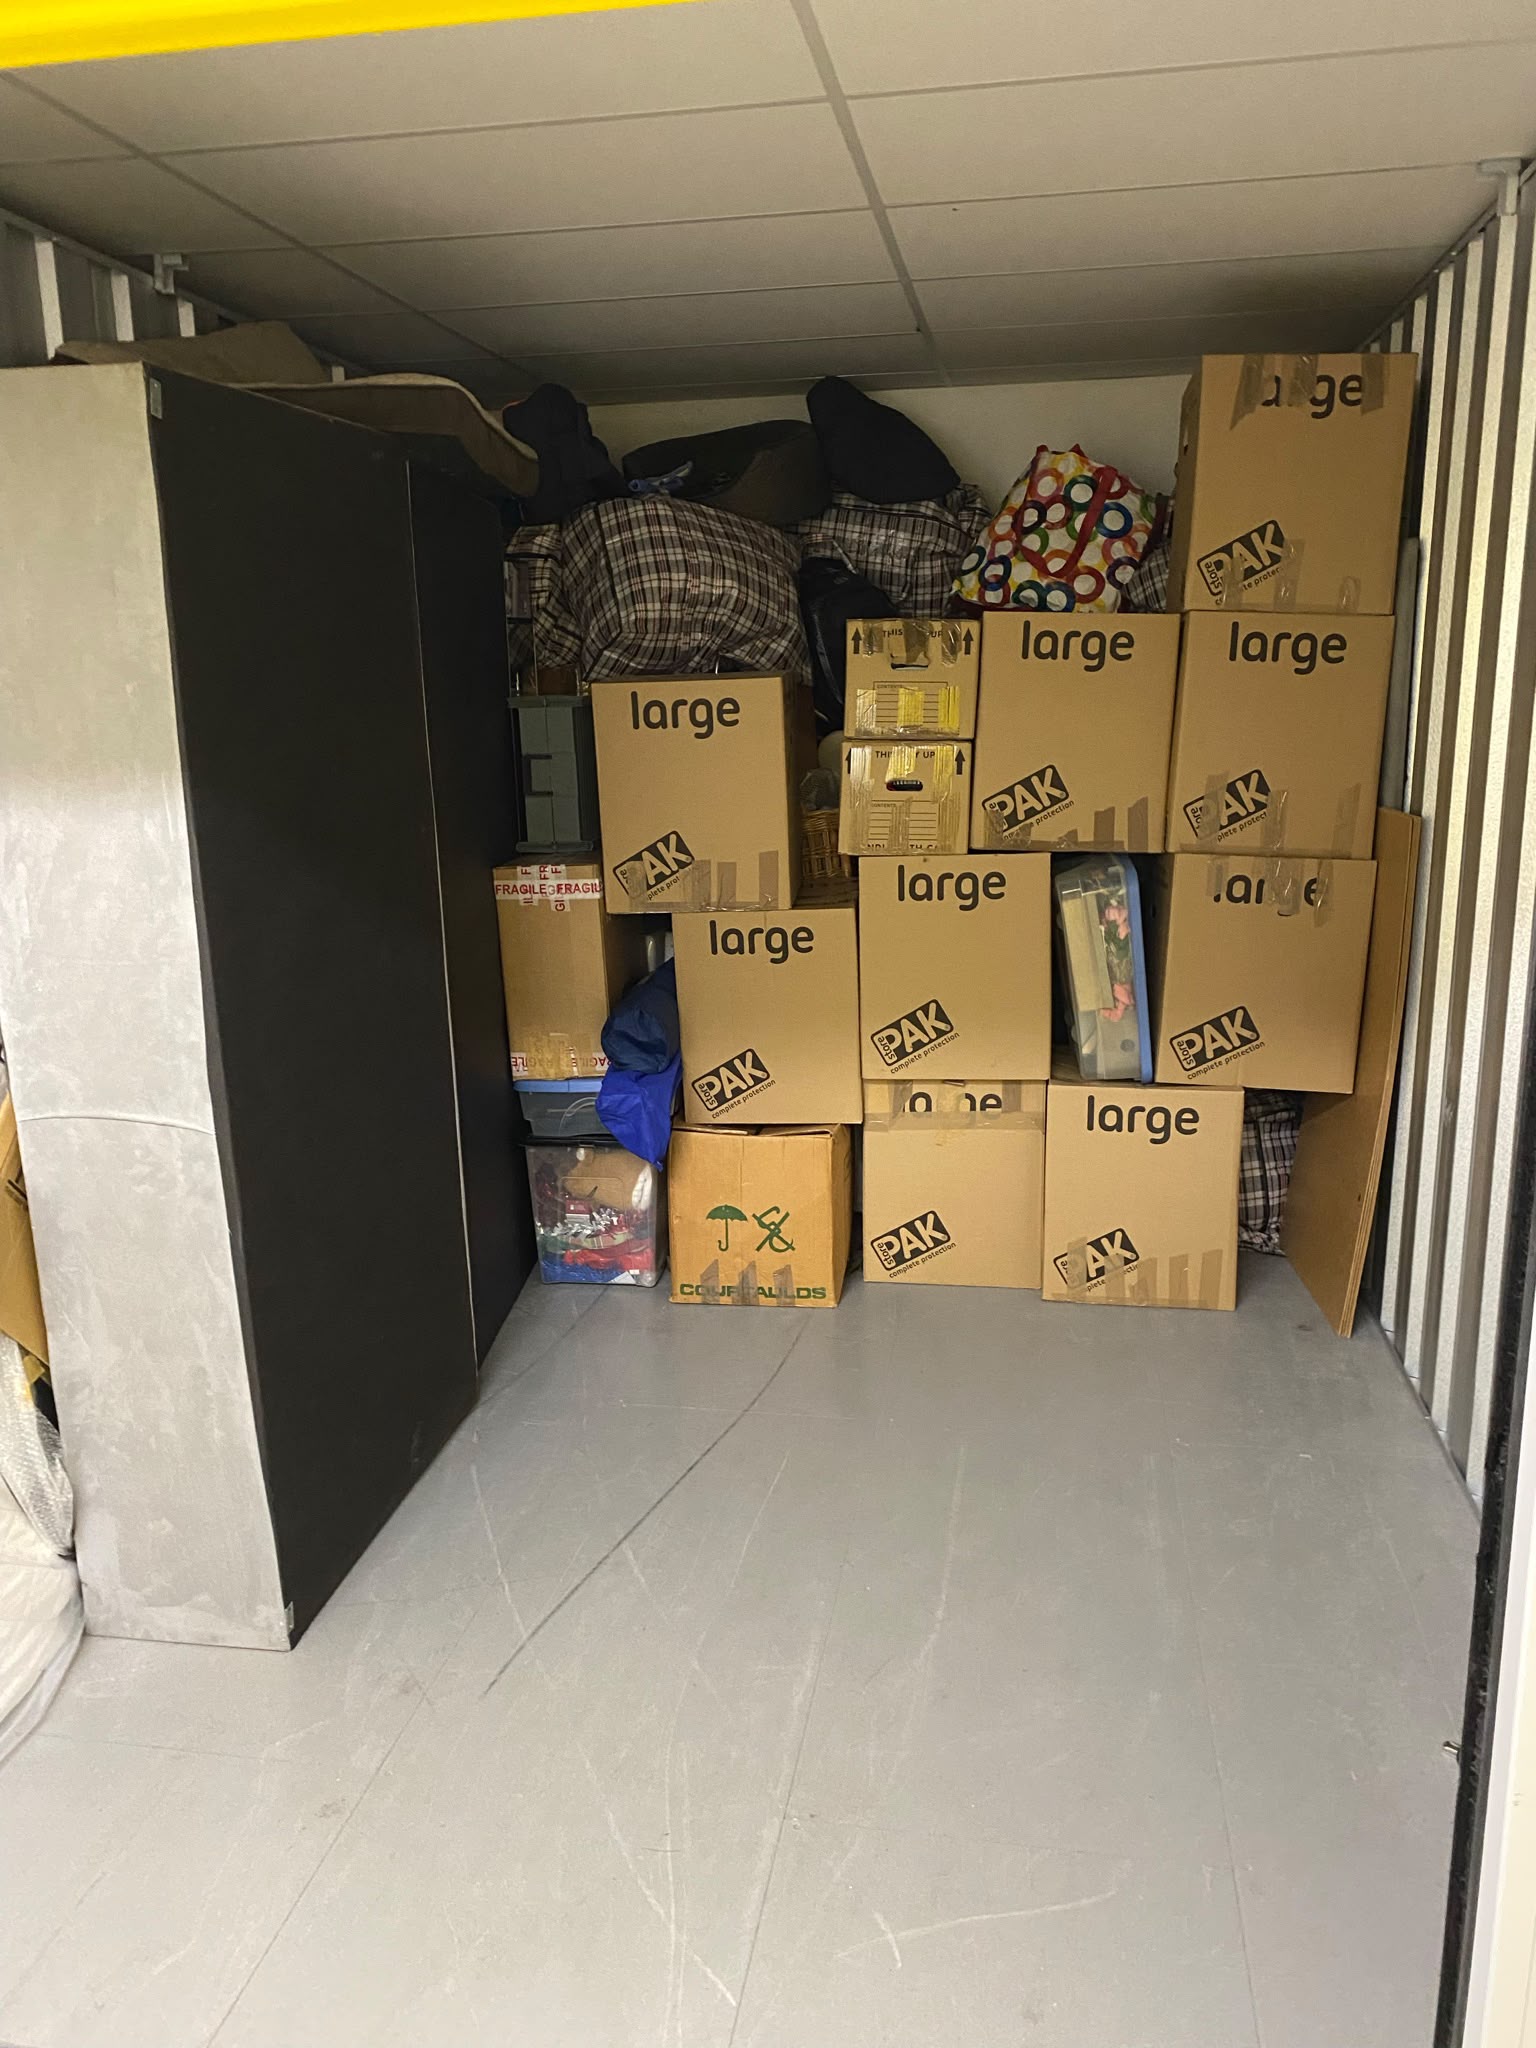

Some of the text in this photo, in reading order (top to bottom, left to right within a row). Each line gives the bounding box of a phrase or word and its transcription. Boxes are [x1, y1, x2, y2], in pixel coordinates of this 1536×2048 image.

[1199, 523, 1288, 593] PAK
[1021, 620, 1135, 673] large
[1229, 622, 1348, 676] large
[631, 690, 741, 740] large
[922, 751, 936, 759] UP
[1035, 799, 1075, 826] protection
[495, 883, 547, 895] FRAGILE
[898, 865, 1007, 912] large
[709, 919, 814, 964] large
[873, 1002, 951, 1064] PAK
[877, 1035, 895, 1060] store
[890, 1032, 960, 1074] complete protection
[1171, 1009, 1256, 1069] PAK
[1176, 1040, 1194, 1065] store
[694, 1051, 768, 1109] PAK
[1187, 1041, 1266, 1080] complete protection
[698, 1082, 716, 1106] store
[711, 1079, 776, 1119] complete protection
[1086, 1094, 1200, 1145] large
[872, 1213, 948, 1269] PAK
[877, 1242, 894, 1265] store
[888, 1241, 957, 1279] complete protection
